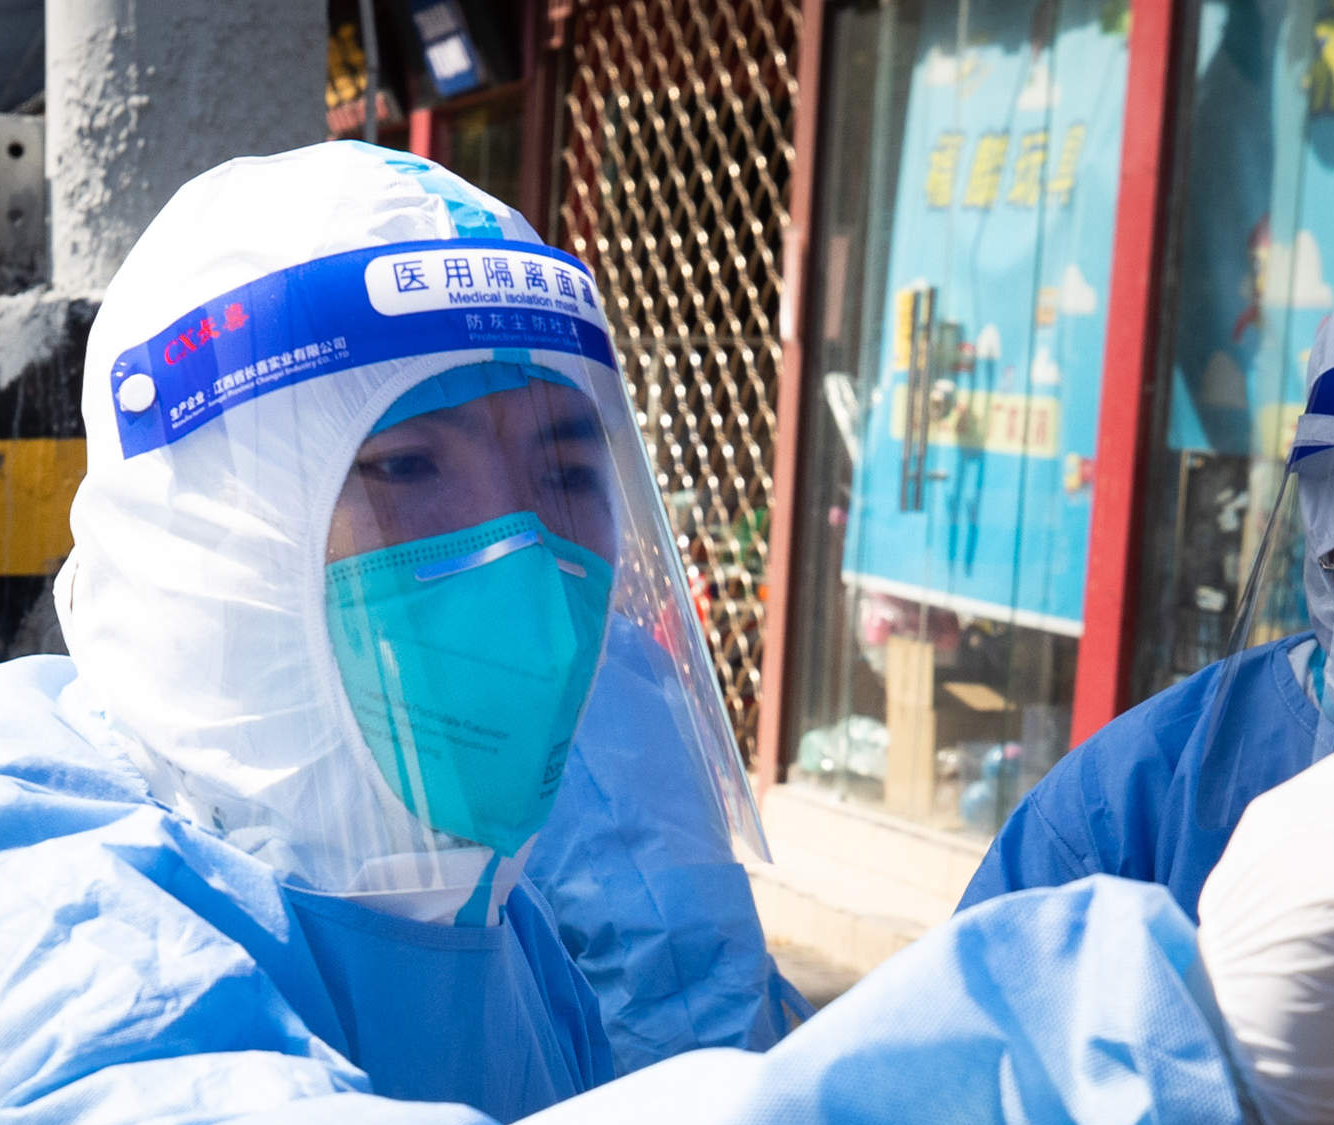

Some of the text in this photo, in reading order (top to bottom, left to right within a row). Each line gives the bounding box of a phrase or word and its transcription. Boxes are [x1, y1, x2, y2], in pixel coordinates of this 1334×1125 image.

[393, 256, 598, 309] 医用隔离面罩
[449, 291, 501, 304] Medical
